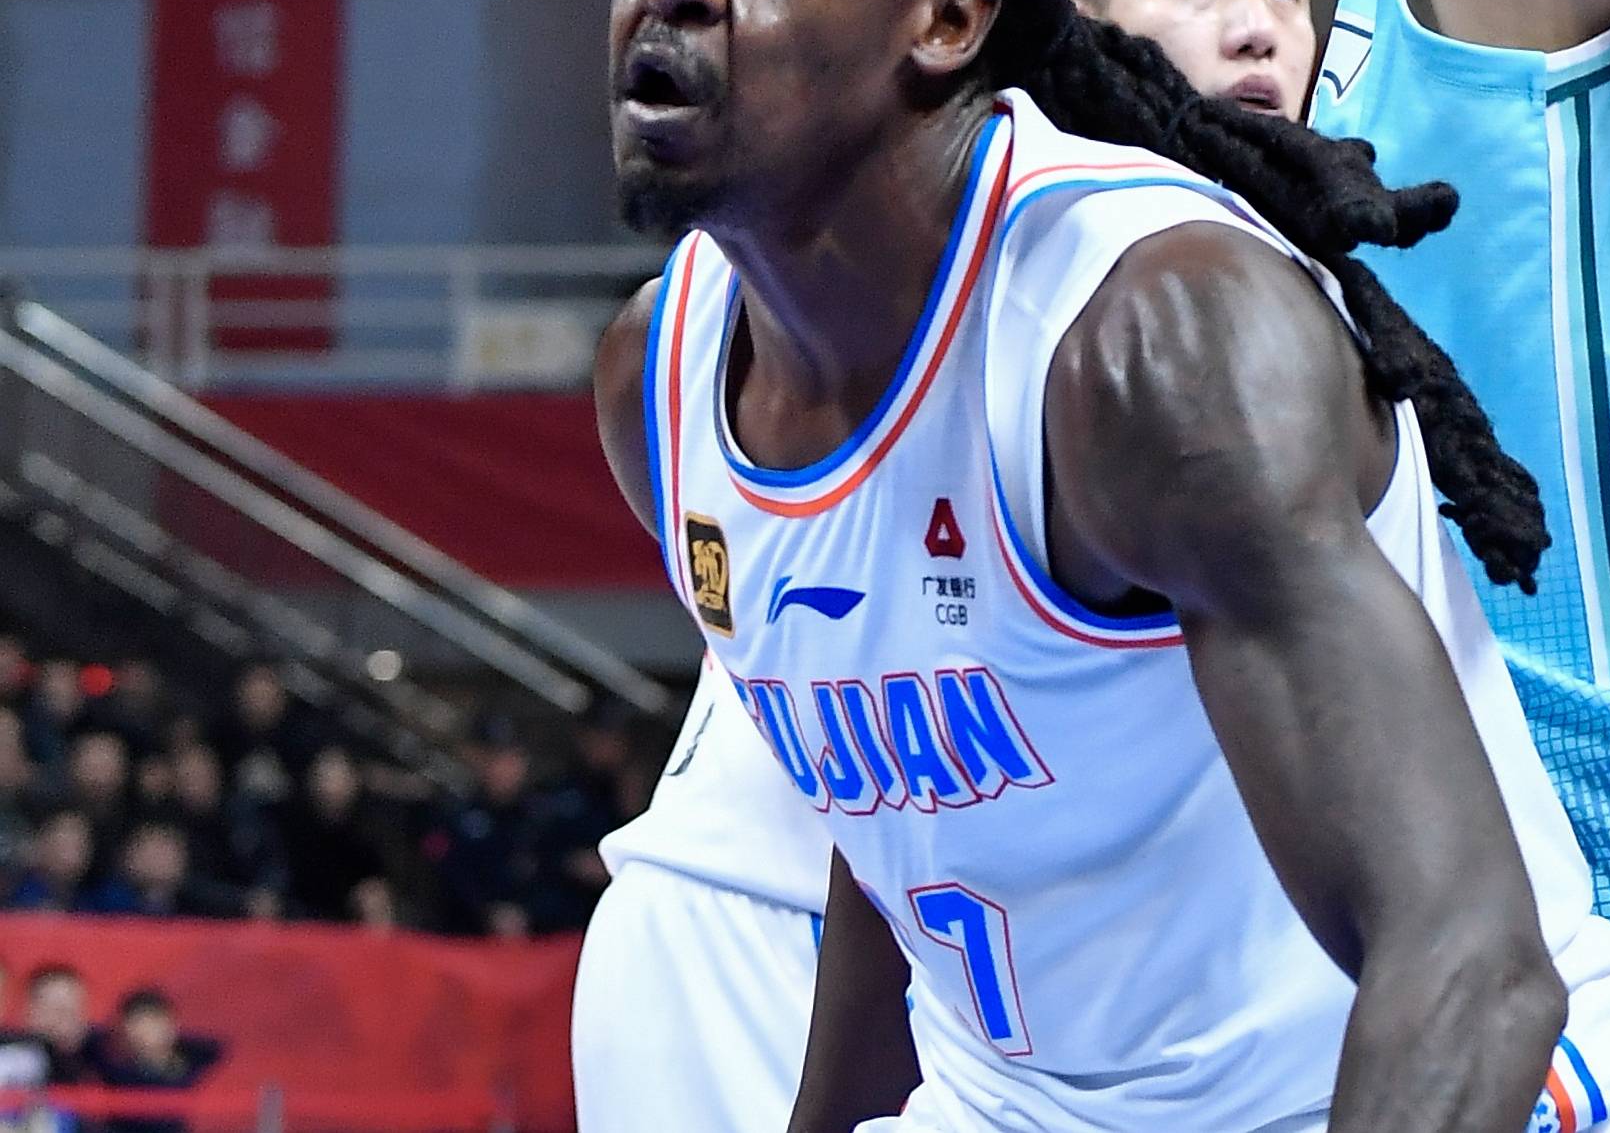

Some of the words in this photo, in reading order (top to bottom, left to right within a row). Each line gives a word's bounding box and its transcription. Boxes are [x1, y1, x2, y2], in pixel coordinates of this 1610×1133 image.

[935, 603, 968, 626] CGB
[728, 667, 1055, 815] UJIAN
[868, 882, 1033, 1056] 7
